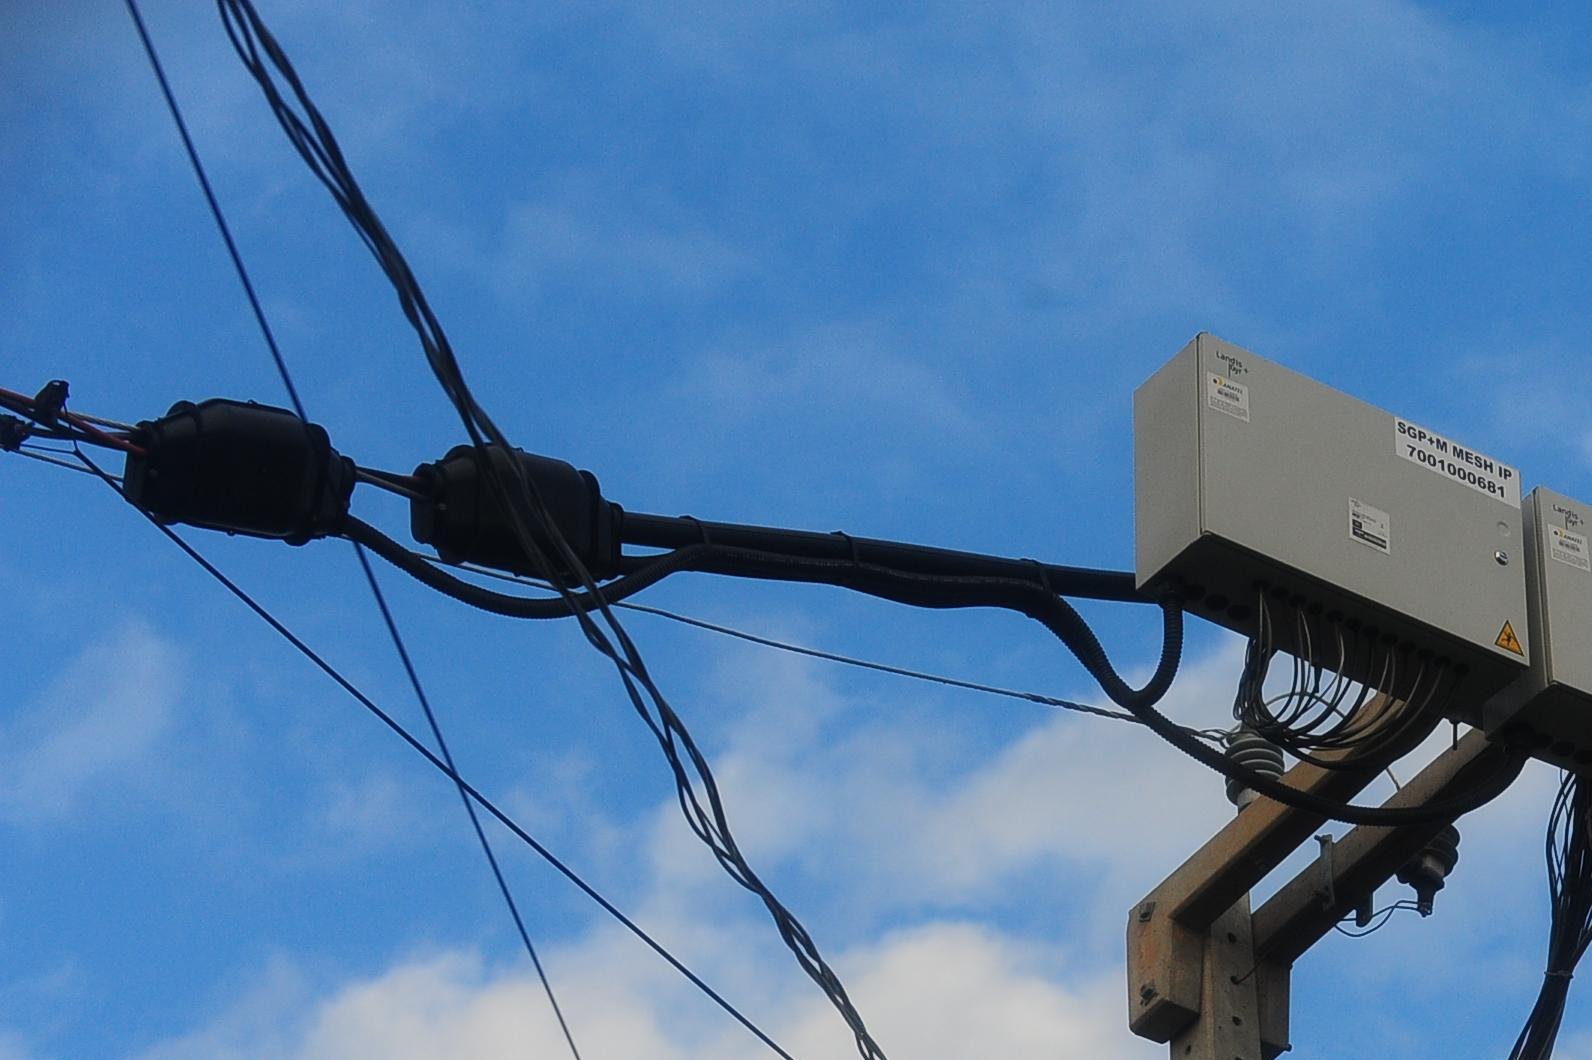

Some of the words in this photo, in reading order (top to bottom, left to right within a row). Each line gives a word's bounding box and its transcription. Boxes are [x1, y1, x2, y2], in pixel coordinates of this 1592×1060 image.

[1397, 421, 1448, 453] SGP+M
[1452, 445, 1494, 474] MESH
[1498, 466, 1512, 480] IP
[1406, 444, 1505, 498] 7001000681
